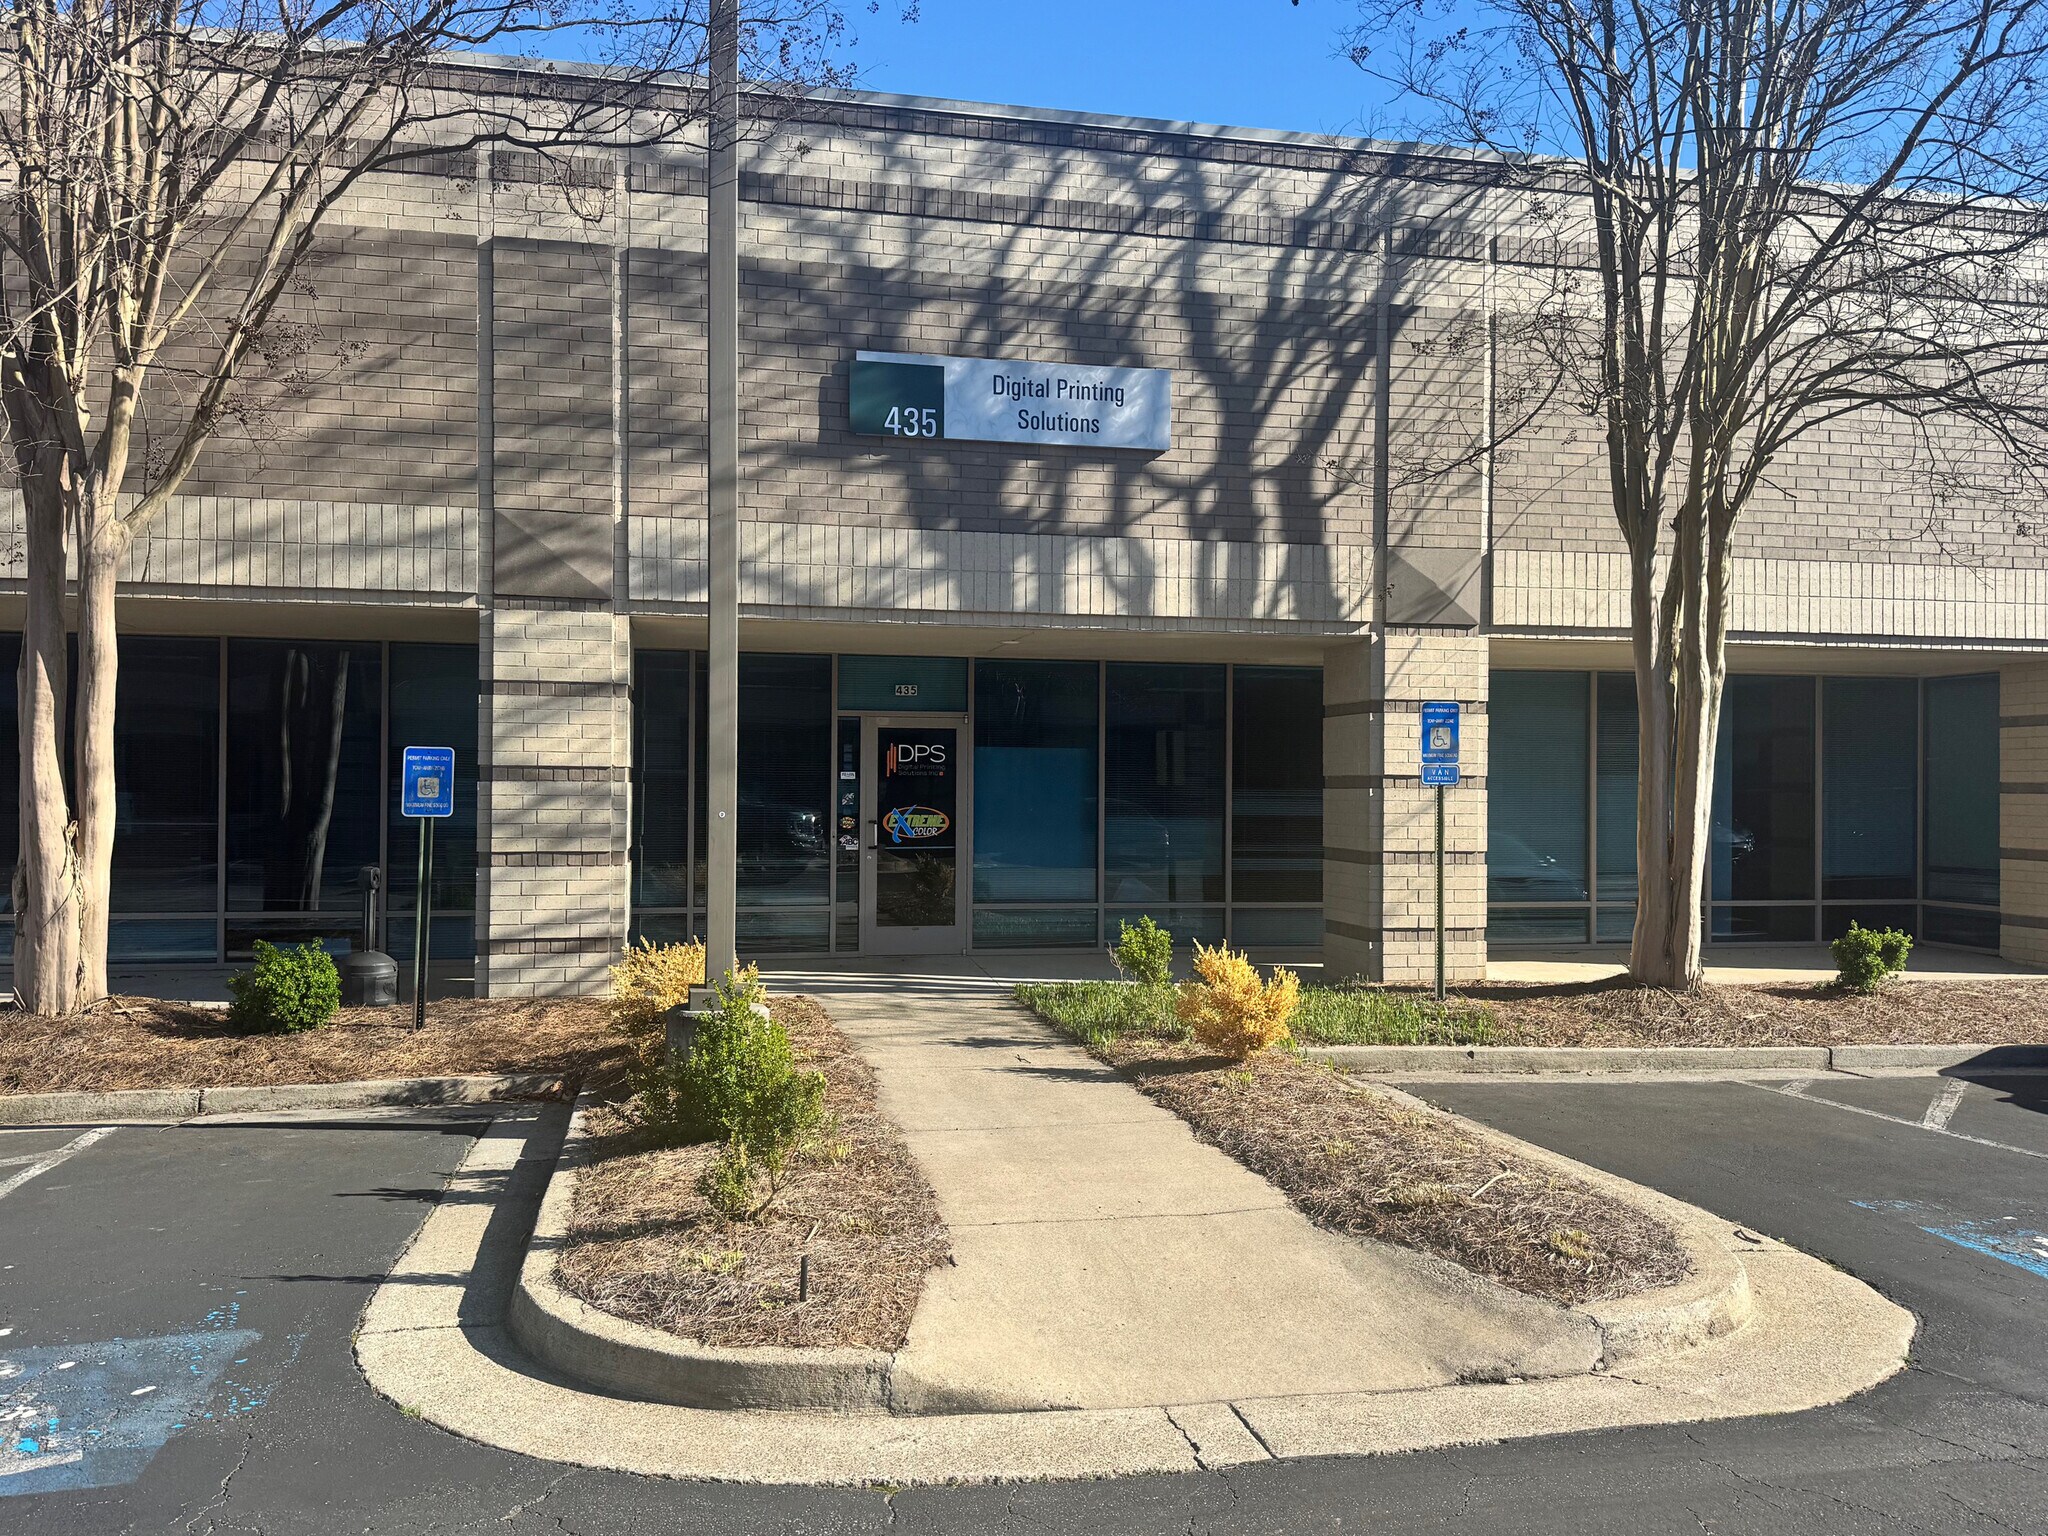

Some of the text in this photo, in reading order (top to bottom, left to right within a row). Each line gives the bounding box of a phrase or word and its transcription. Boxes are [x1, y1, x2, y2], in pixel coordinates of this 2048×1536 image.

[993, 374, 1125, 407] Digital Printing
[884, 406, 937, 438] 435
[1018, 409, 1100, 433] Solutions
[896, 685, 917, 695] 435
[898, 744, 946, 763] DPS
[912, 827, 938, 836] COLOR
